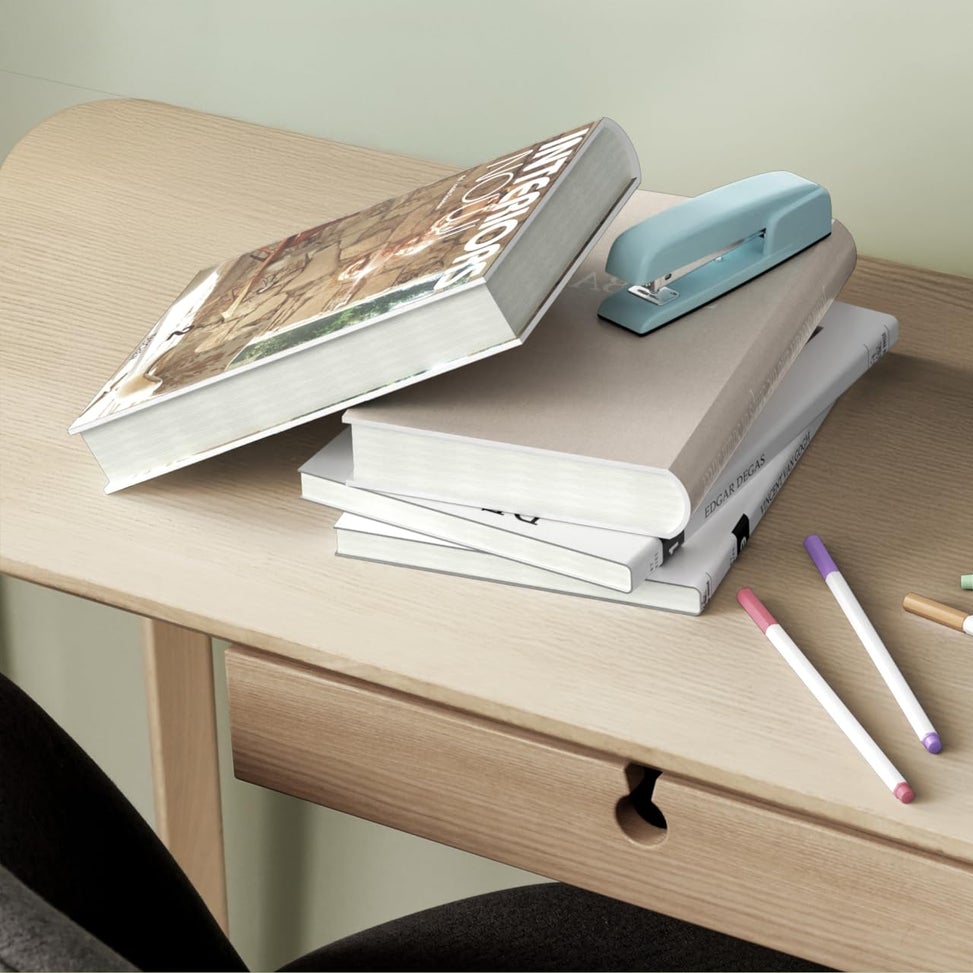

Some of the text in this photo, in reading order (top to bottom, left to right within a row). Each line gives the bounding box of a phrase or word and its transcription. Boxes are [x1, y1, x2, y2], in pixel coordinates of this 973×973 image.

[433, 127, 589, 291] INTERIORS
[704, 482, 736, 519] EDGAR
[736, 453, 766, 490] DEGAS
